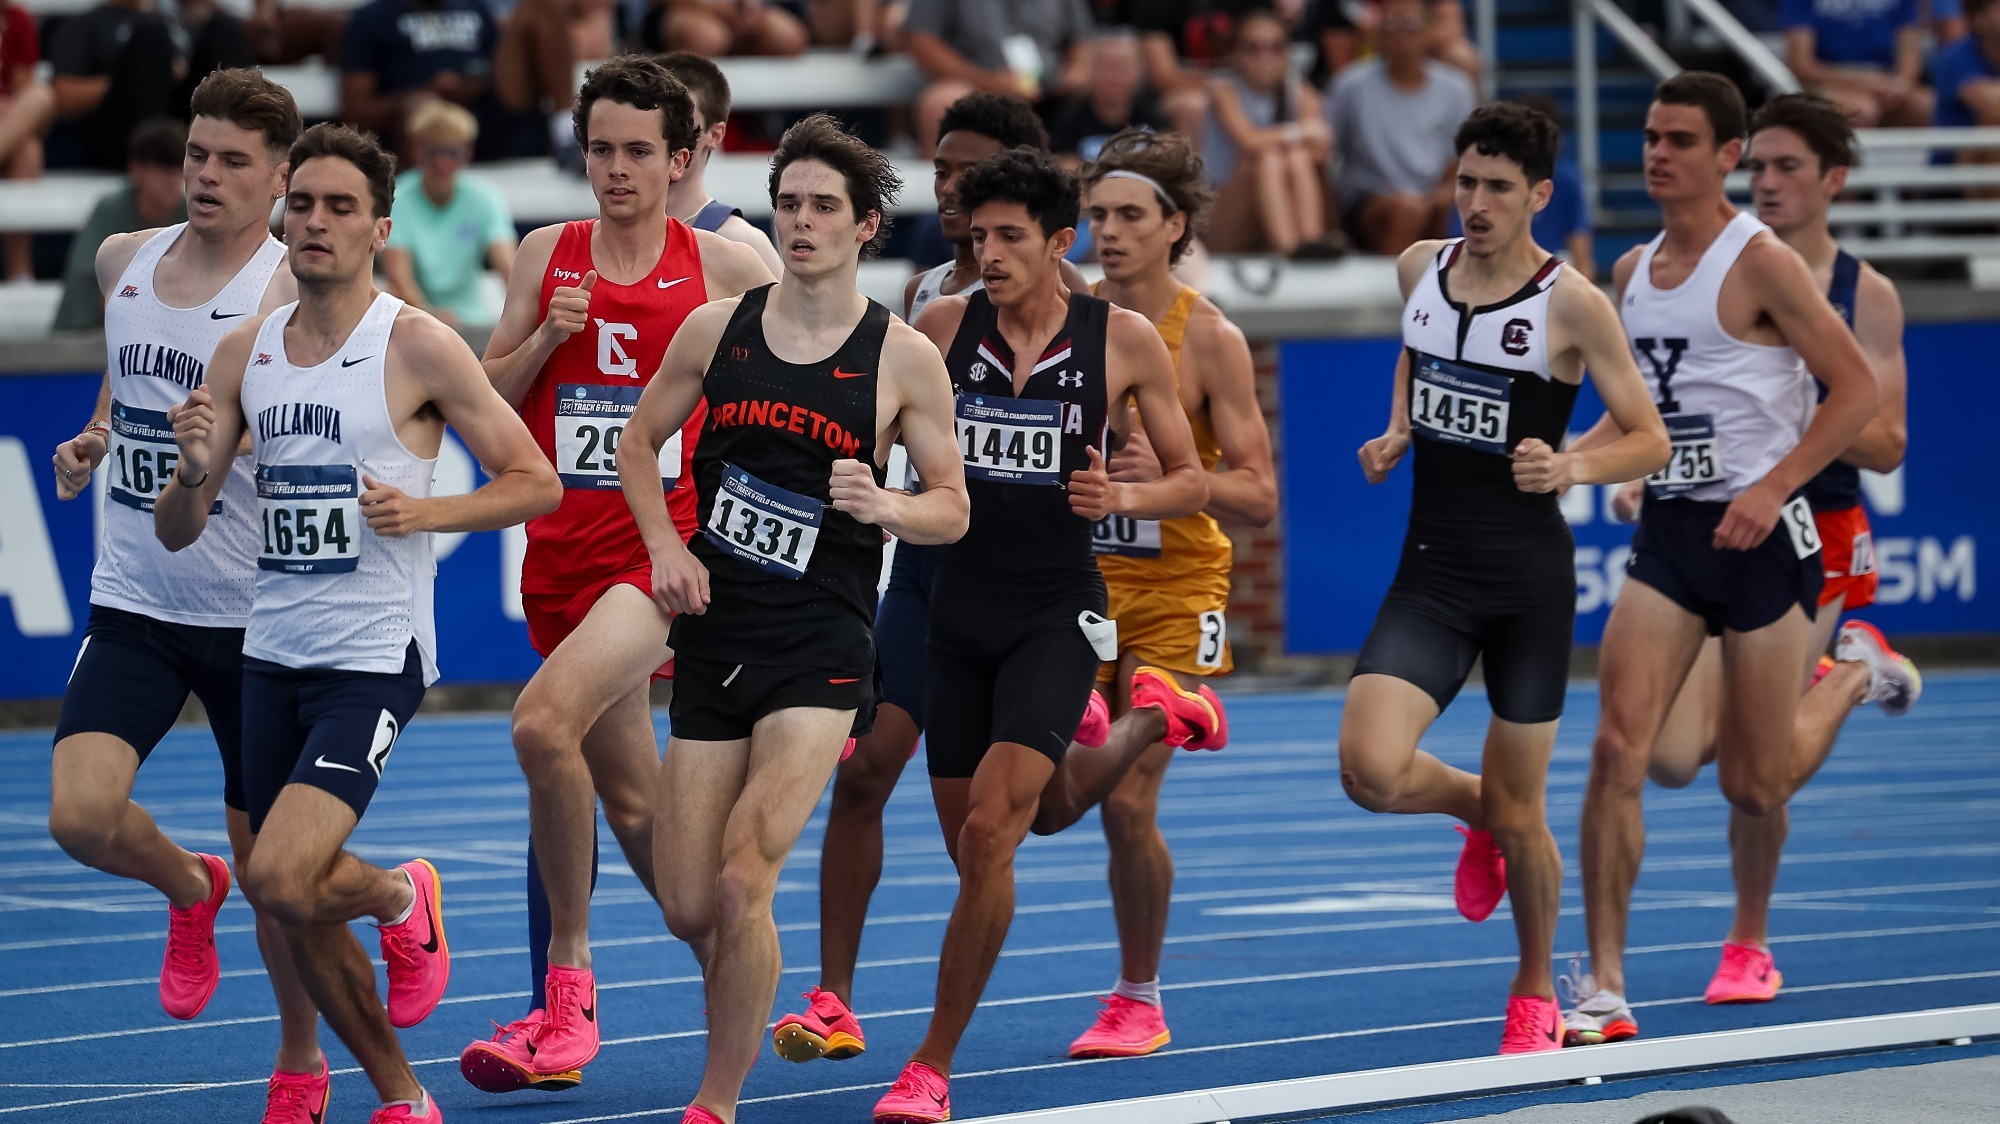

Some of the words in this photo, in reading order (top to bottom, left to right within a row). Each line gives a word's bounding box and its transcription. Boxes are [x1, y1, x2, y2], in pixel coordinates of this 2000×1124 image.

[553, 267, 571, 280] Ivy
[119, 344, 204, 391] VILLANOVA
[970, 362, 987, 381] SEC
[1635, 338, 1688, 413] Y
[258, 403, 342, 445] VILLANOVA
[573, 403, 595, 411] TRACK
[601, 405, 619, 413] FIELD
[620, 405, 637, 413] CHA
[712, 400, 860, 458] PRINCETON
[974, 408, 990, 417] TRACK
[994, 411, 1008, 419] FIELD
[1009, 412, 1054, 421] CHAMPIONSHIPS
[1419, 387, 1500, 439] 1455
[138, 427, 155, 437] FIELD
[576, 424, 624, 471] 29
[964, 425, 1053, 470] 1449
[117, 444, 179, 494] 165
[1651, 444, 1714, 480] 755
[279, 485, 296, 494] FIELD
[296, 483, 351, 494] CHAMPIONSHIPS
[736, 483, 752, 498] TRACK
[754, 495, 771, 505] FIELD
[770, 500, 815, 520] CHAMPIONSHIPS
[262, 508, 351, 556] 1654
[715, 498, 804, 566] 1331
[1204, 614, 1222, 663] 3
[374, 719, 396, 777] 2
